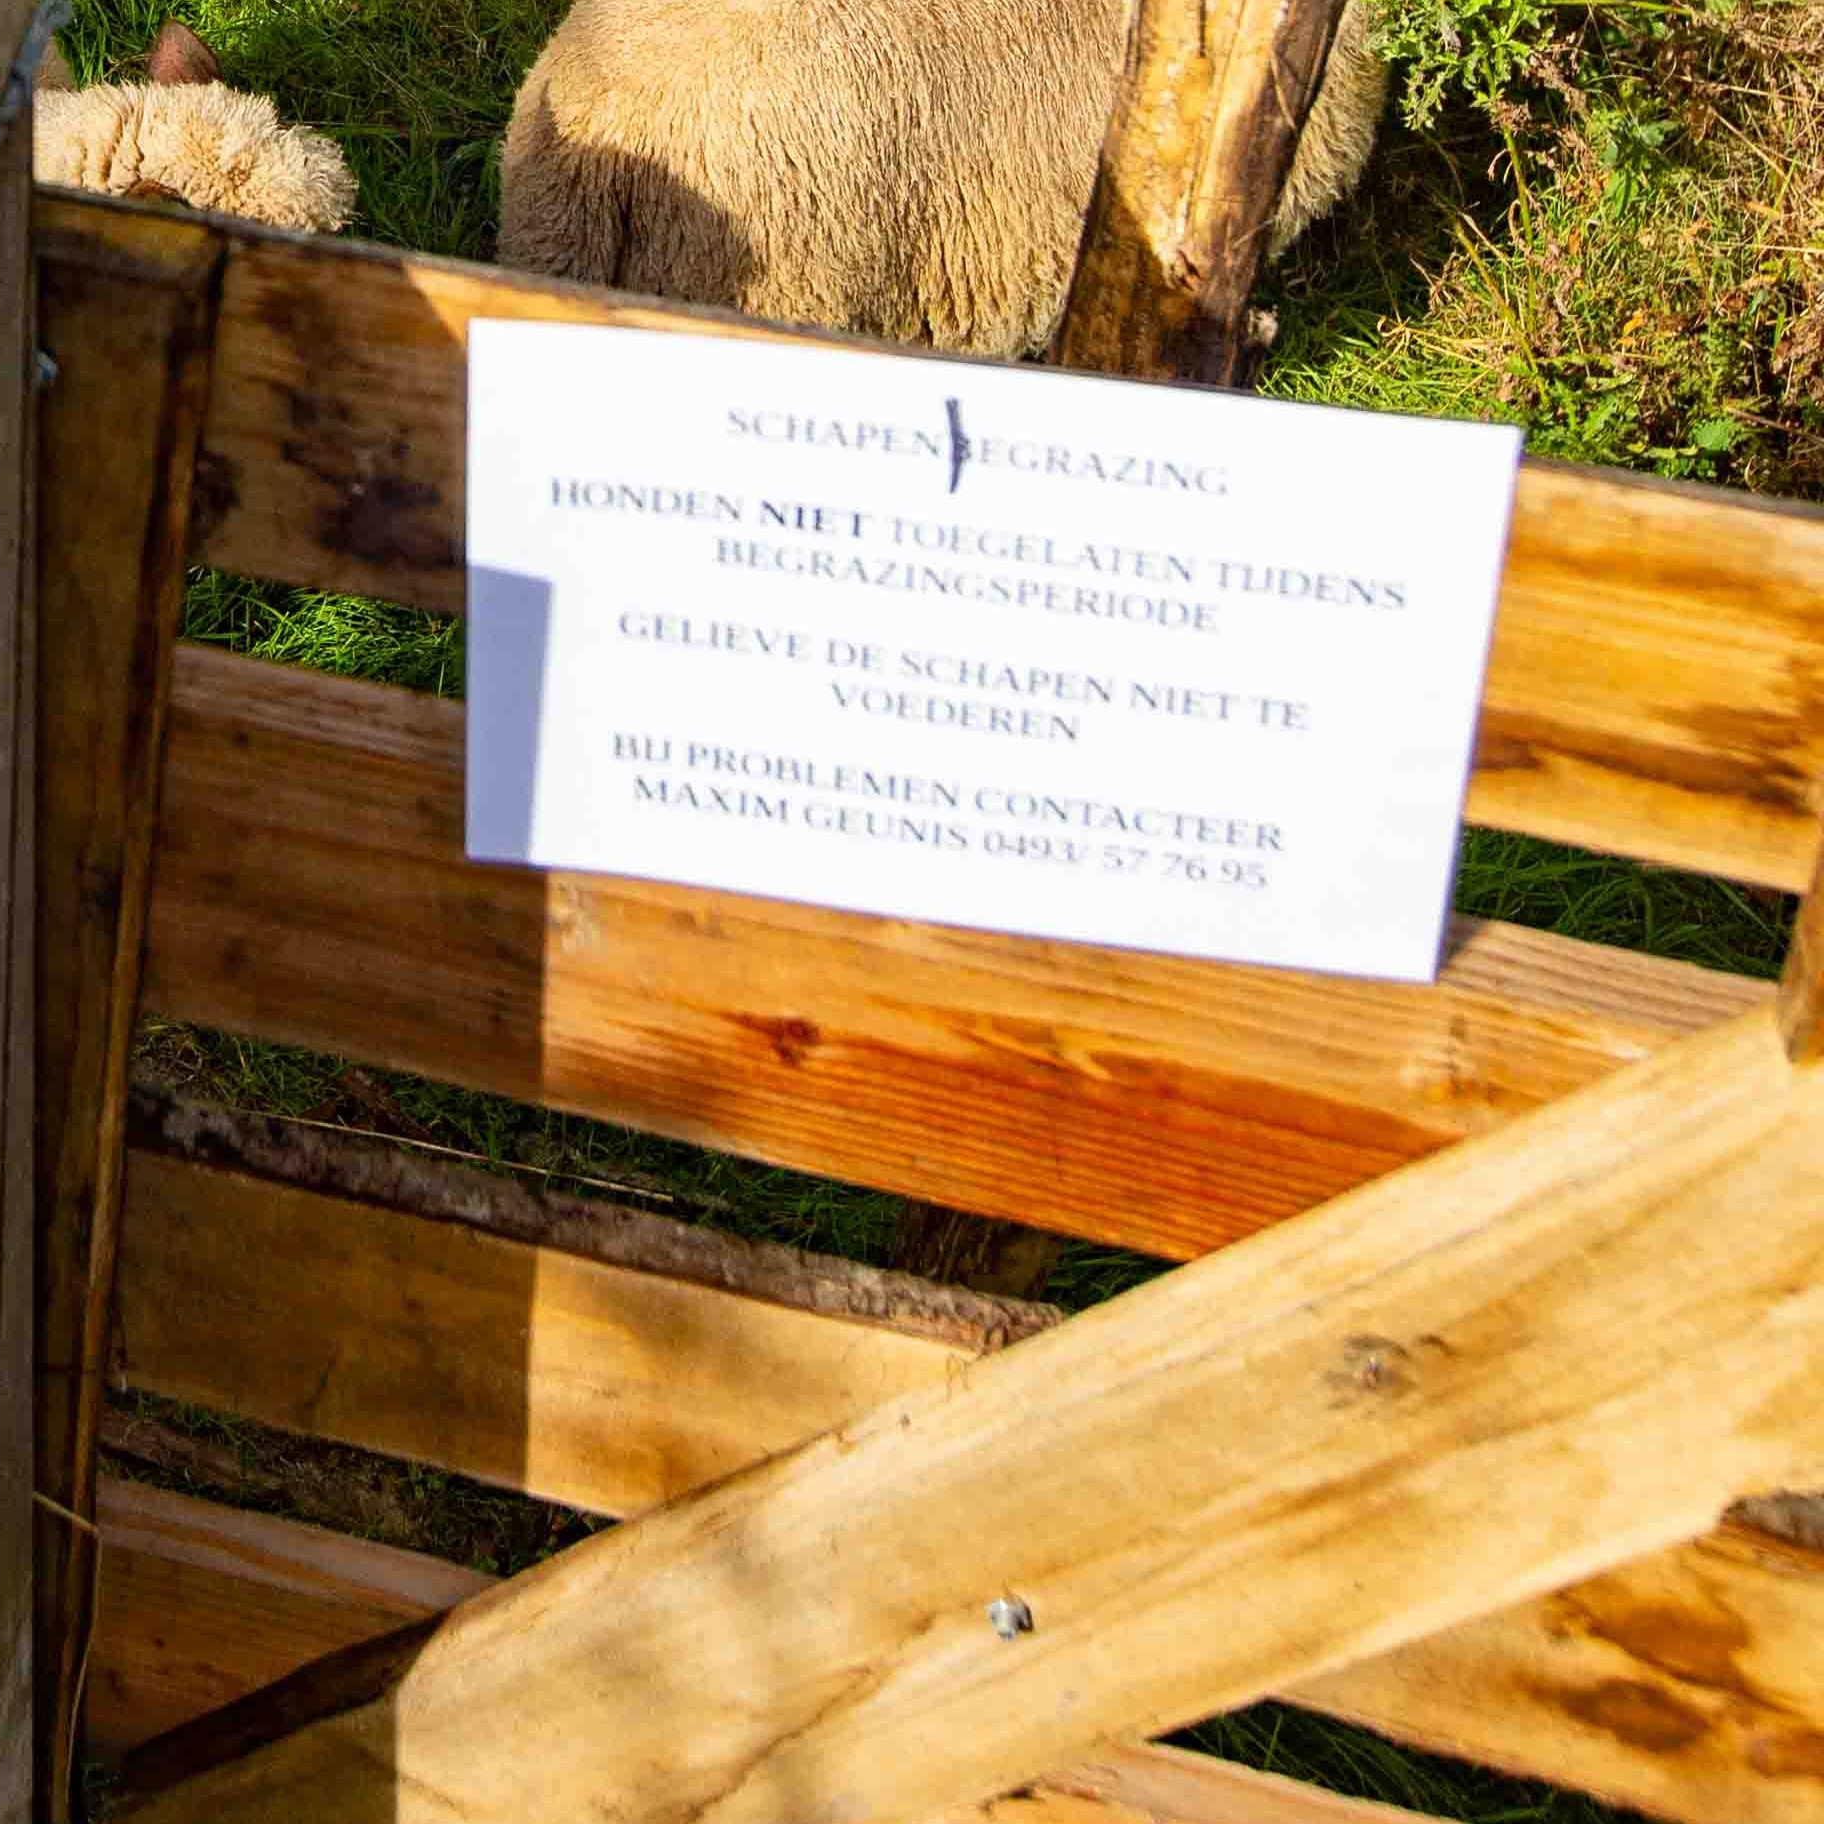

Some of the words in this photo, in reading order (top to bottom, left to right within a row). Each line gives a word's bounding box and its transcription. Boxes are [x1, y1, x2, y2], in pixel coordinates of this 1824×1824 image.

[551, 478, 742, 521] HONDEN
[759, 499, 872, 538] NIET
[888, 515, 1193, 582] TOEGELATEN
[1217, 561, 1408, 609] TIJDENS
[715, 536, 1220, 633] BEGRAZINGSPERIODE
[619, 610, 811, 661] GELIEVE
[826, 638, 883, 670] DE
[900, 650, 1114, 703] SCHAPEN
[1129, 680, 1240, 722] NIET
[1254, 696, 1310, 731] TE
[830, 681, 1080, 742] VOEDEREN
[612, 732, 672, 763] BIJ
[687, 741, 959, 808] PROBLEMEN
[974, 785, 1283, 853] CONTACTEER
[634, 775, 793, 824] MAXIM
[803, 805, 969, 850] GEUNIS
[1219, 858, 1269, 890] 95
